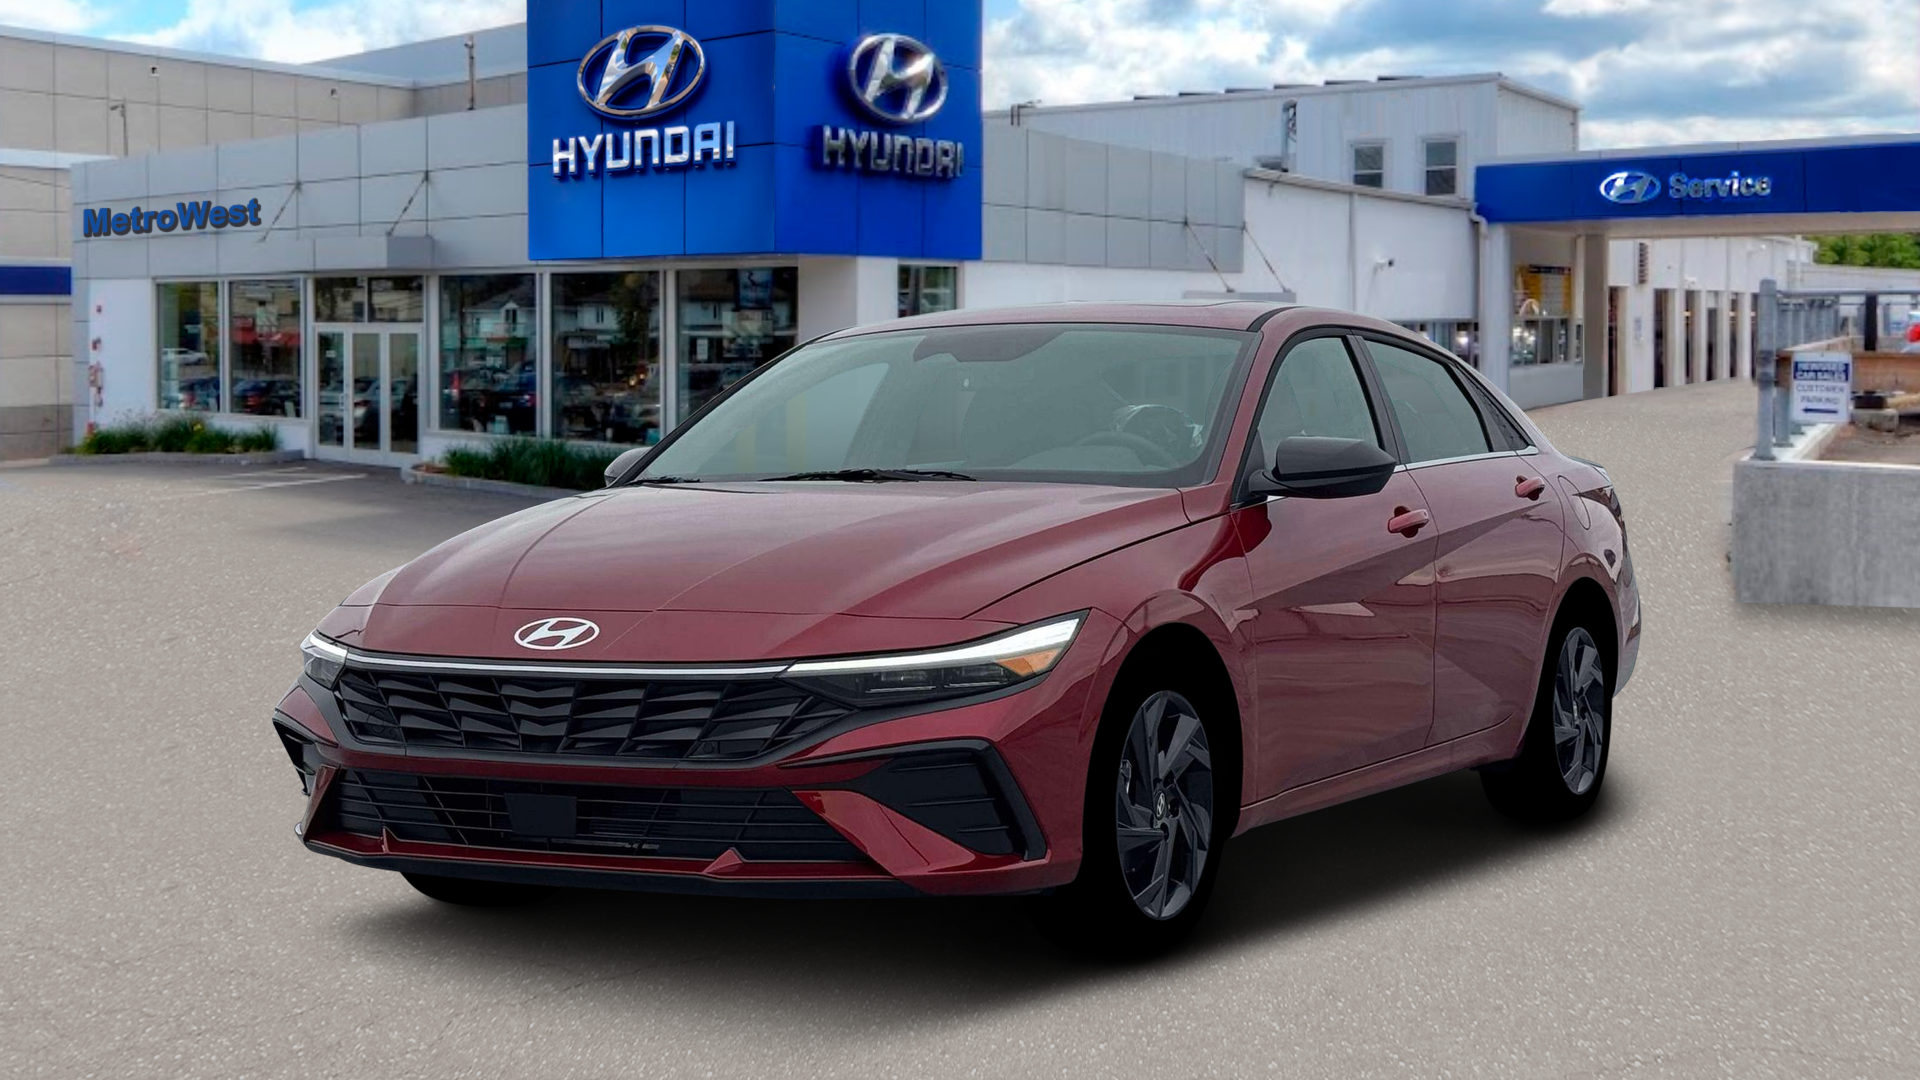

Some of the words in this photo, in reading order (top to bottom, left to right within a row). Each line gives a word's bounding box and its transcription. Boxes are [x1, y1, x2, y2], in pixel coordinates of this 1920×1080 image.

[553, 121, 735, 177] HYUNDAI
[822, 125, 965, 178] HYUNDAI
[1669, 170, 1772, 198] Service
[83, 198, 261, 237] MetroWest
